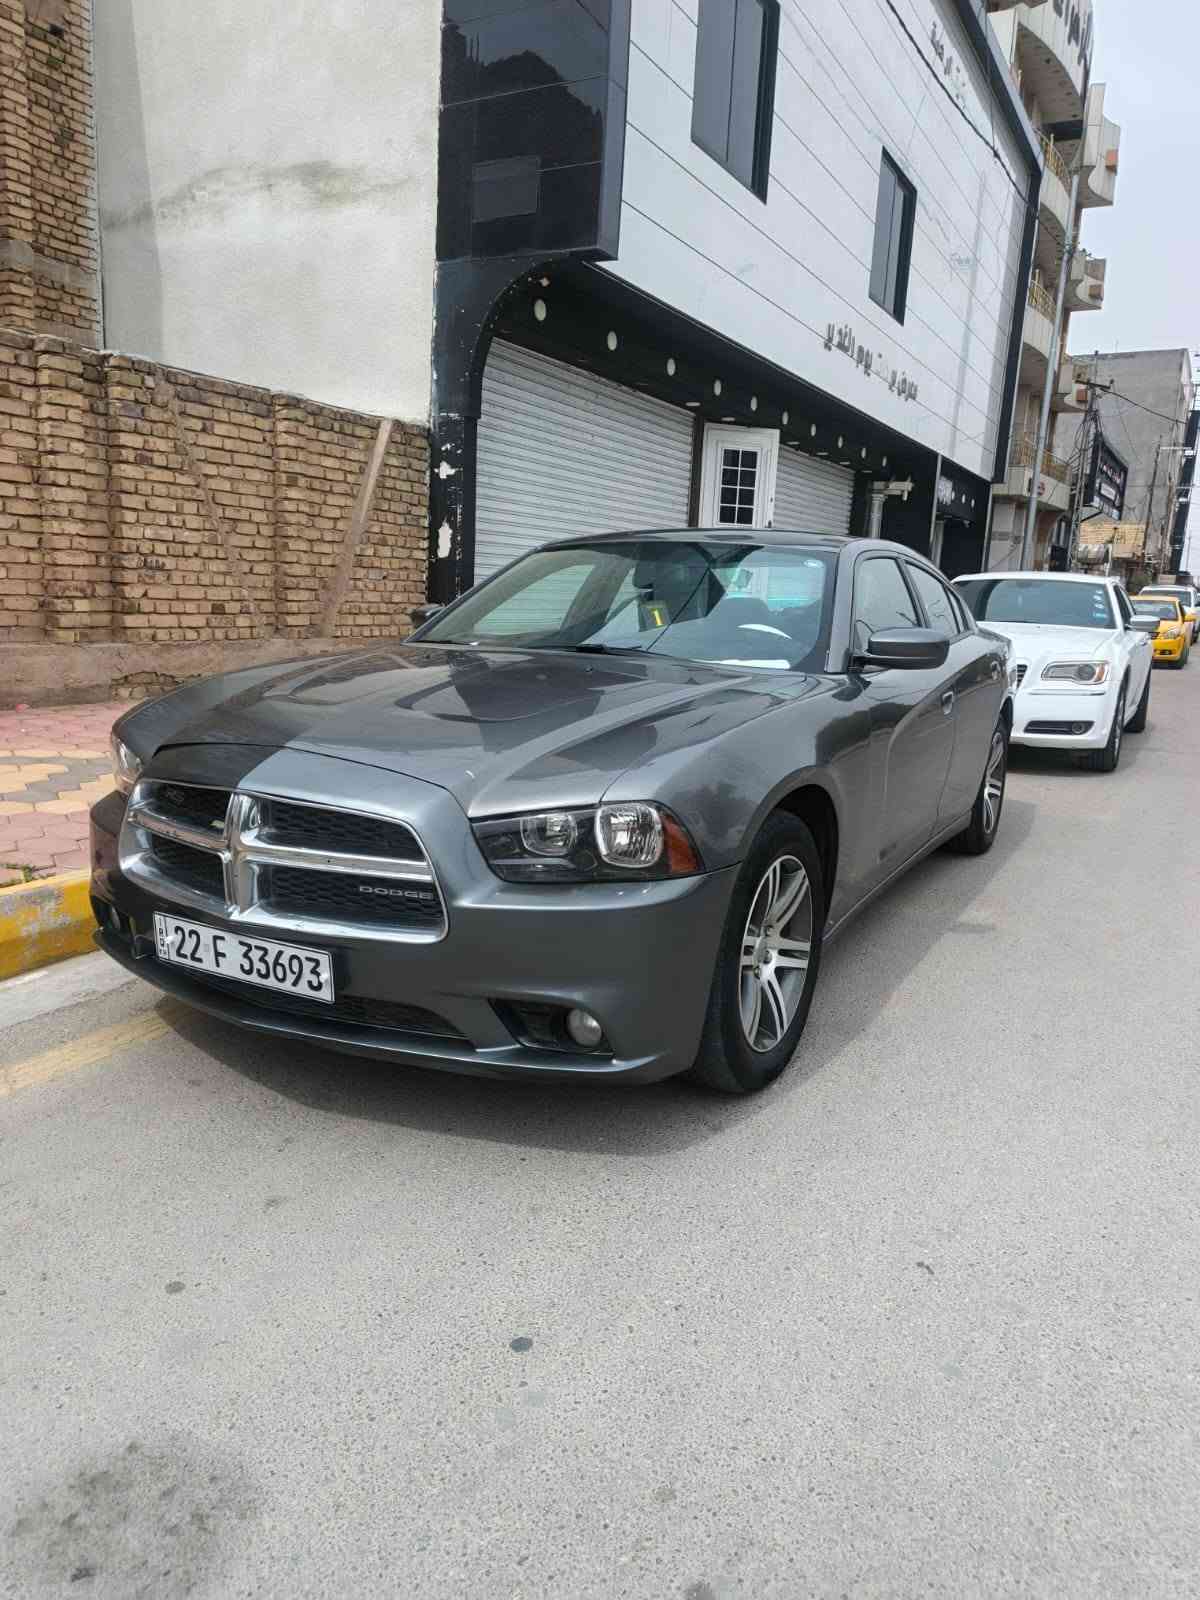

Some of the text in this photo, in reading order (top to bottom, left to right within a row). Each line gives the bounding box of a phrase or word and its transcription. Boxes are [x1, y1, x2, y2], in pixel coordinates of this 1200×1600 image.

[357, 885, 434, 900] DODGE
[174, 925, 324, 992] 22 F 33693
